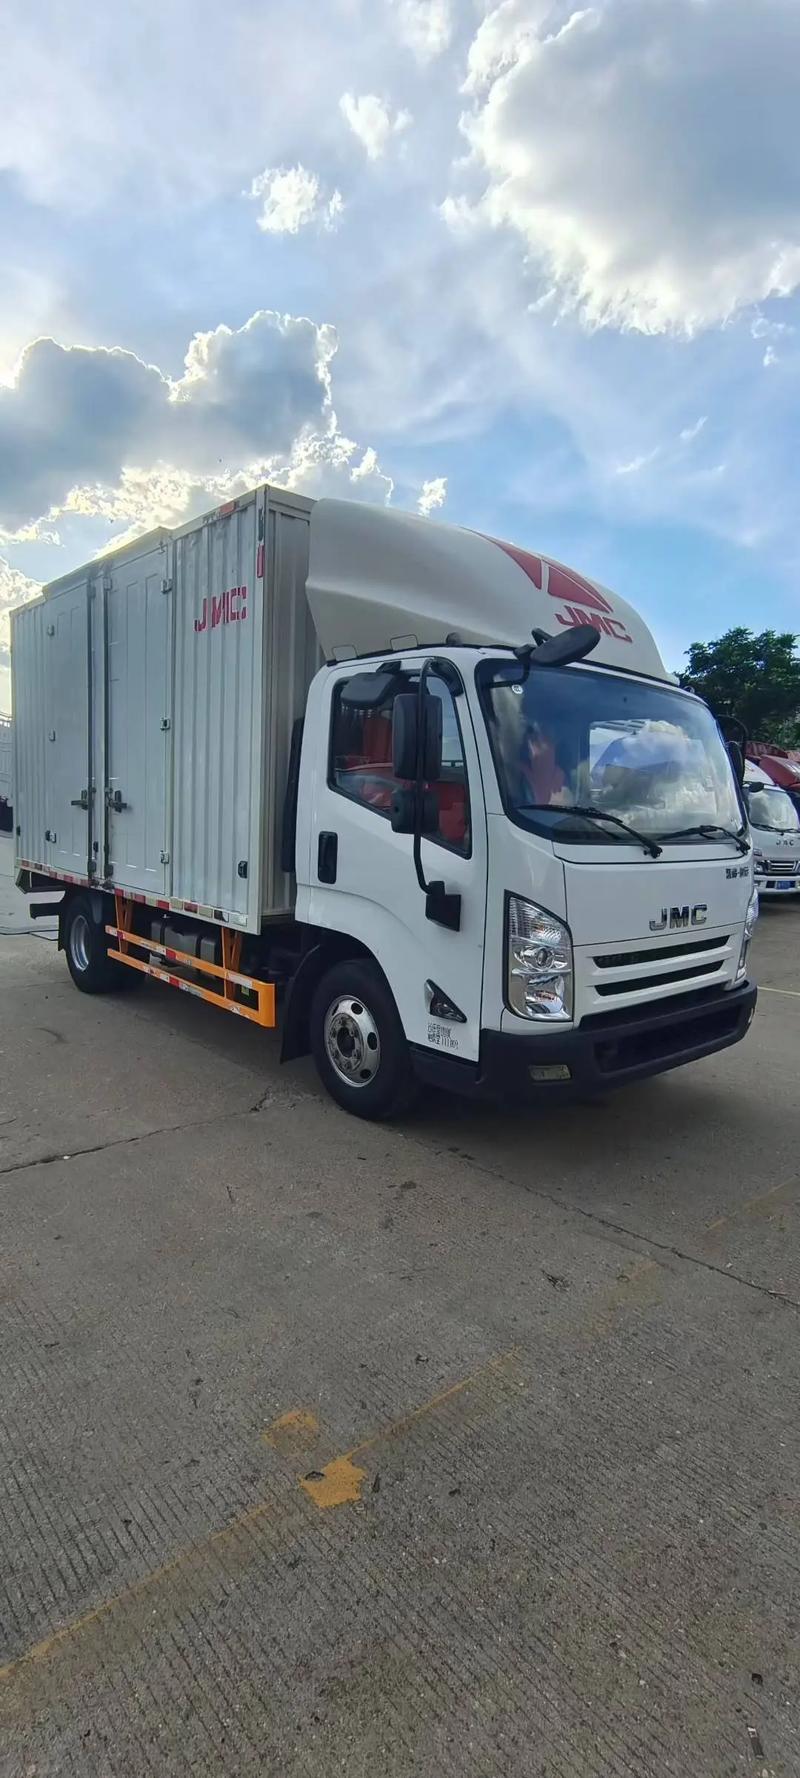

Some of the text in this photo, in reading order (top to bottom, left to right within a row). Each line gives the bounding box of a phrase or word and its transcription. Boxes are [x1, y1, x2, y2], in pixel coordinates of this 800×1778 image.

[194, 586, 247, 632] JMC
[554, 604, 633, 643] JMC
[649, 903, 708, 931] JMC
